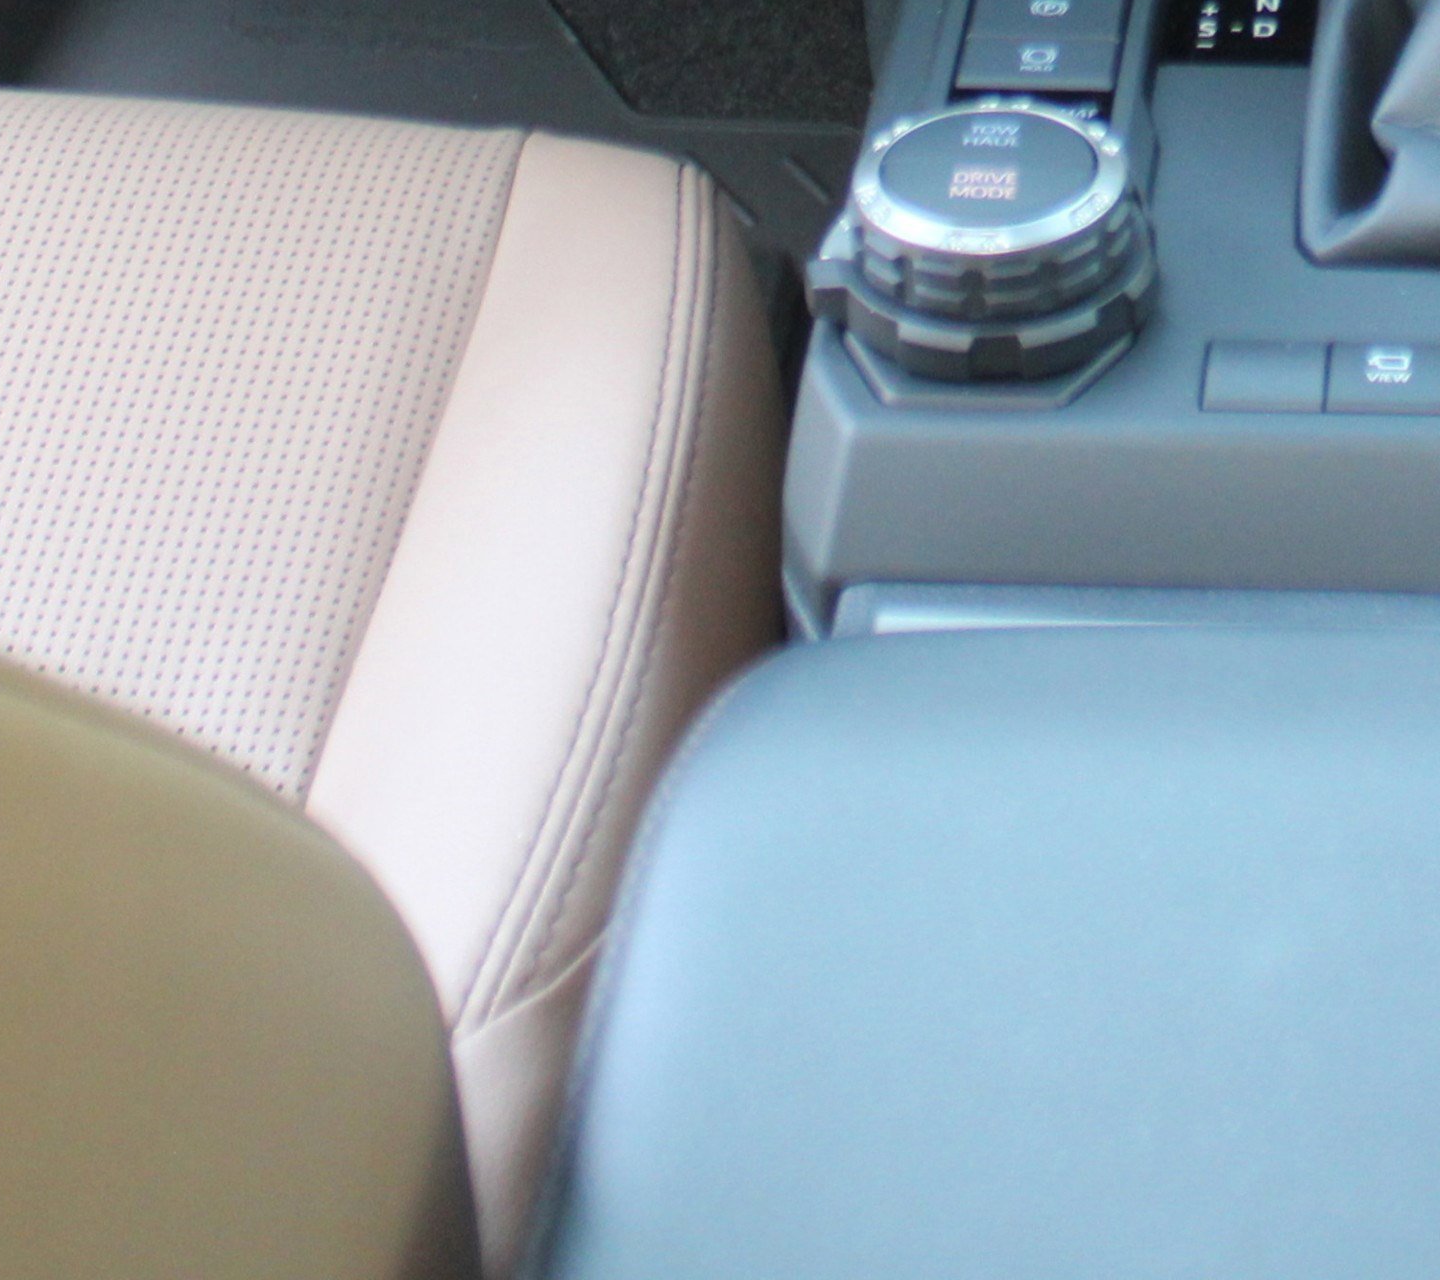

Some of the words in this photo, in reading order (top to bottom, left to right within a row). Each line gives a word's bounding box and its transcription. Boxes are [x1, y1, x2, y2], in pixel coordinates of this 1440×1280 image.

[1197, 20, 1218, 38] S
[1252, 20, 1278, 39] D
[971, 124, 1021, 137] TOW
[953, 171, 1017, 186] DRIVE
[949, 186, 1017, 200] MODE
[1366, 372, 1413, 384] VIEW
